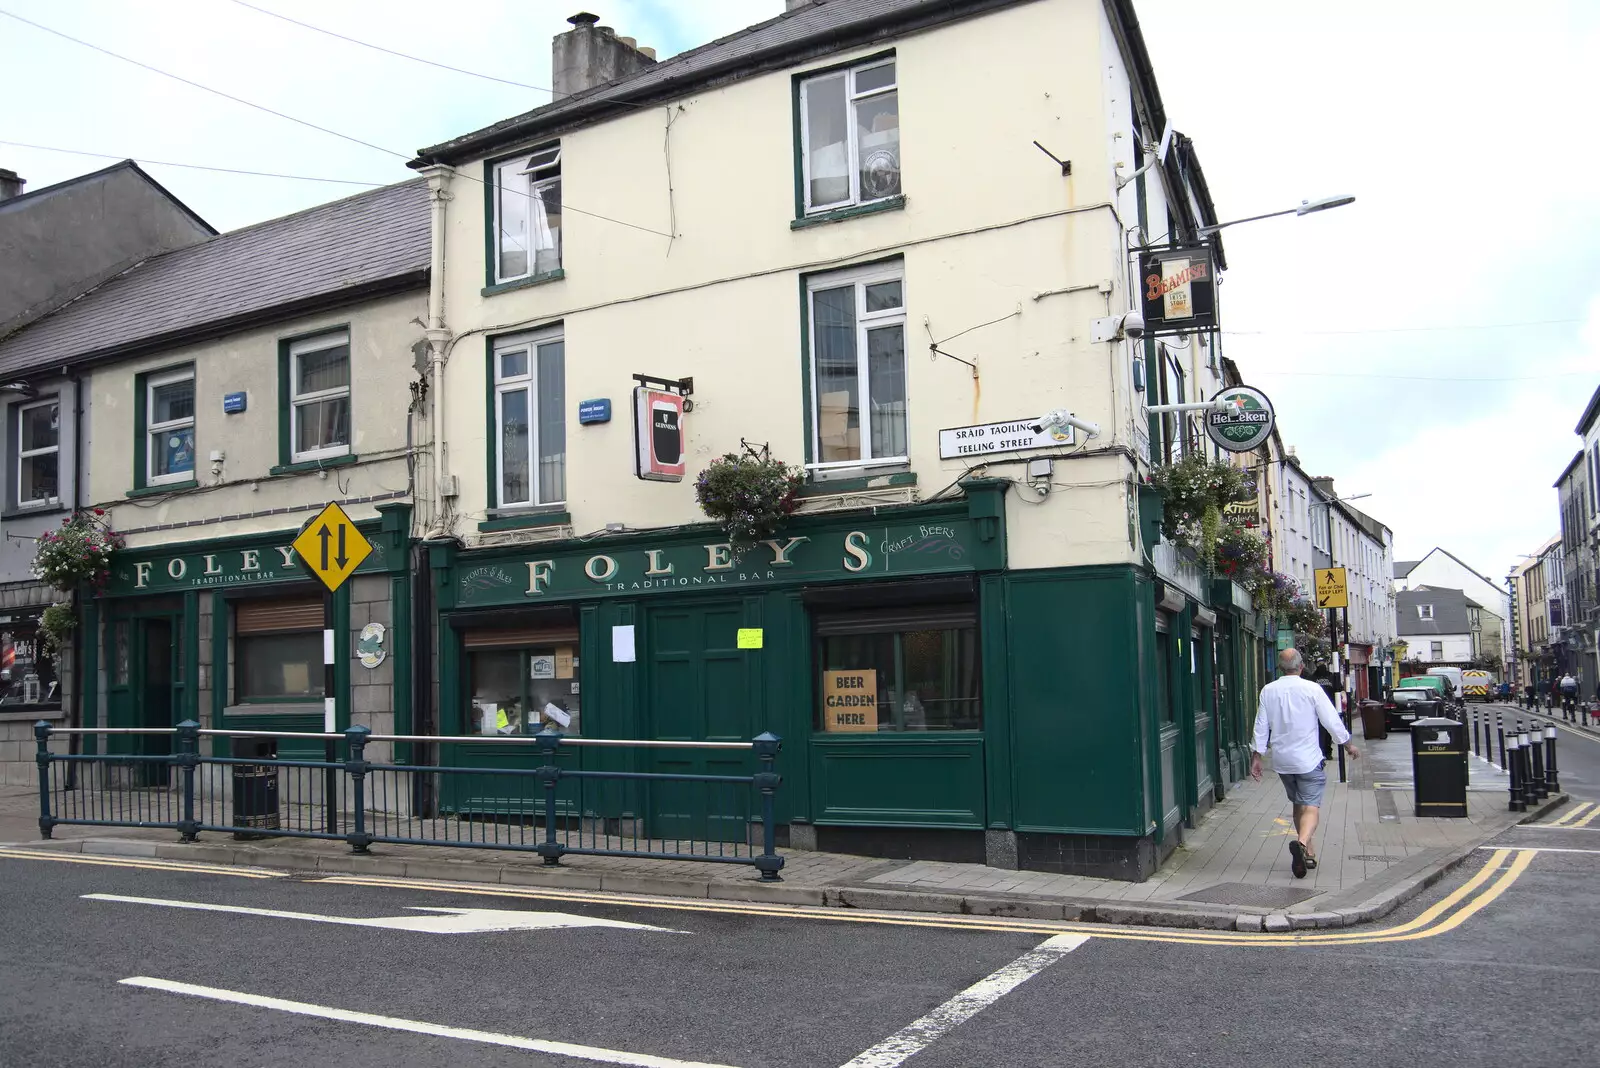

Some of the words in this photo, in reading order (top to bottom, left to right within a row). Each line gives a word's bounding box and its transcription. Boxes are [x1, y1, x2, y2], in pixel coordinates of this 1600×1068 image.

[1146, 263, 1207, 301] BEAMISH
[1212, 411, 1267, 424] Heieken
[655, 422, 677, 430] GUINNESS
[958, 442, 994, 454] TEELING
[1000, 437, 1034, 449] STREET
[192, 574, 252, 586] TRADITIONAL
[257, 571, 274, 579] BAR
[606, 576, 726, 591] TRADITIONAL
[739, 570, 776, 581] BAR
[836, 676, 864, 689] BEER
[826, 694, 875, 707] GARDEN
[836, 713, 866, 725] HERE
